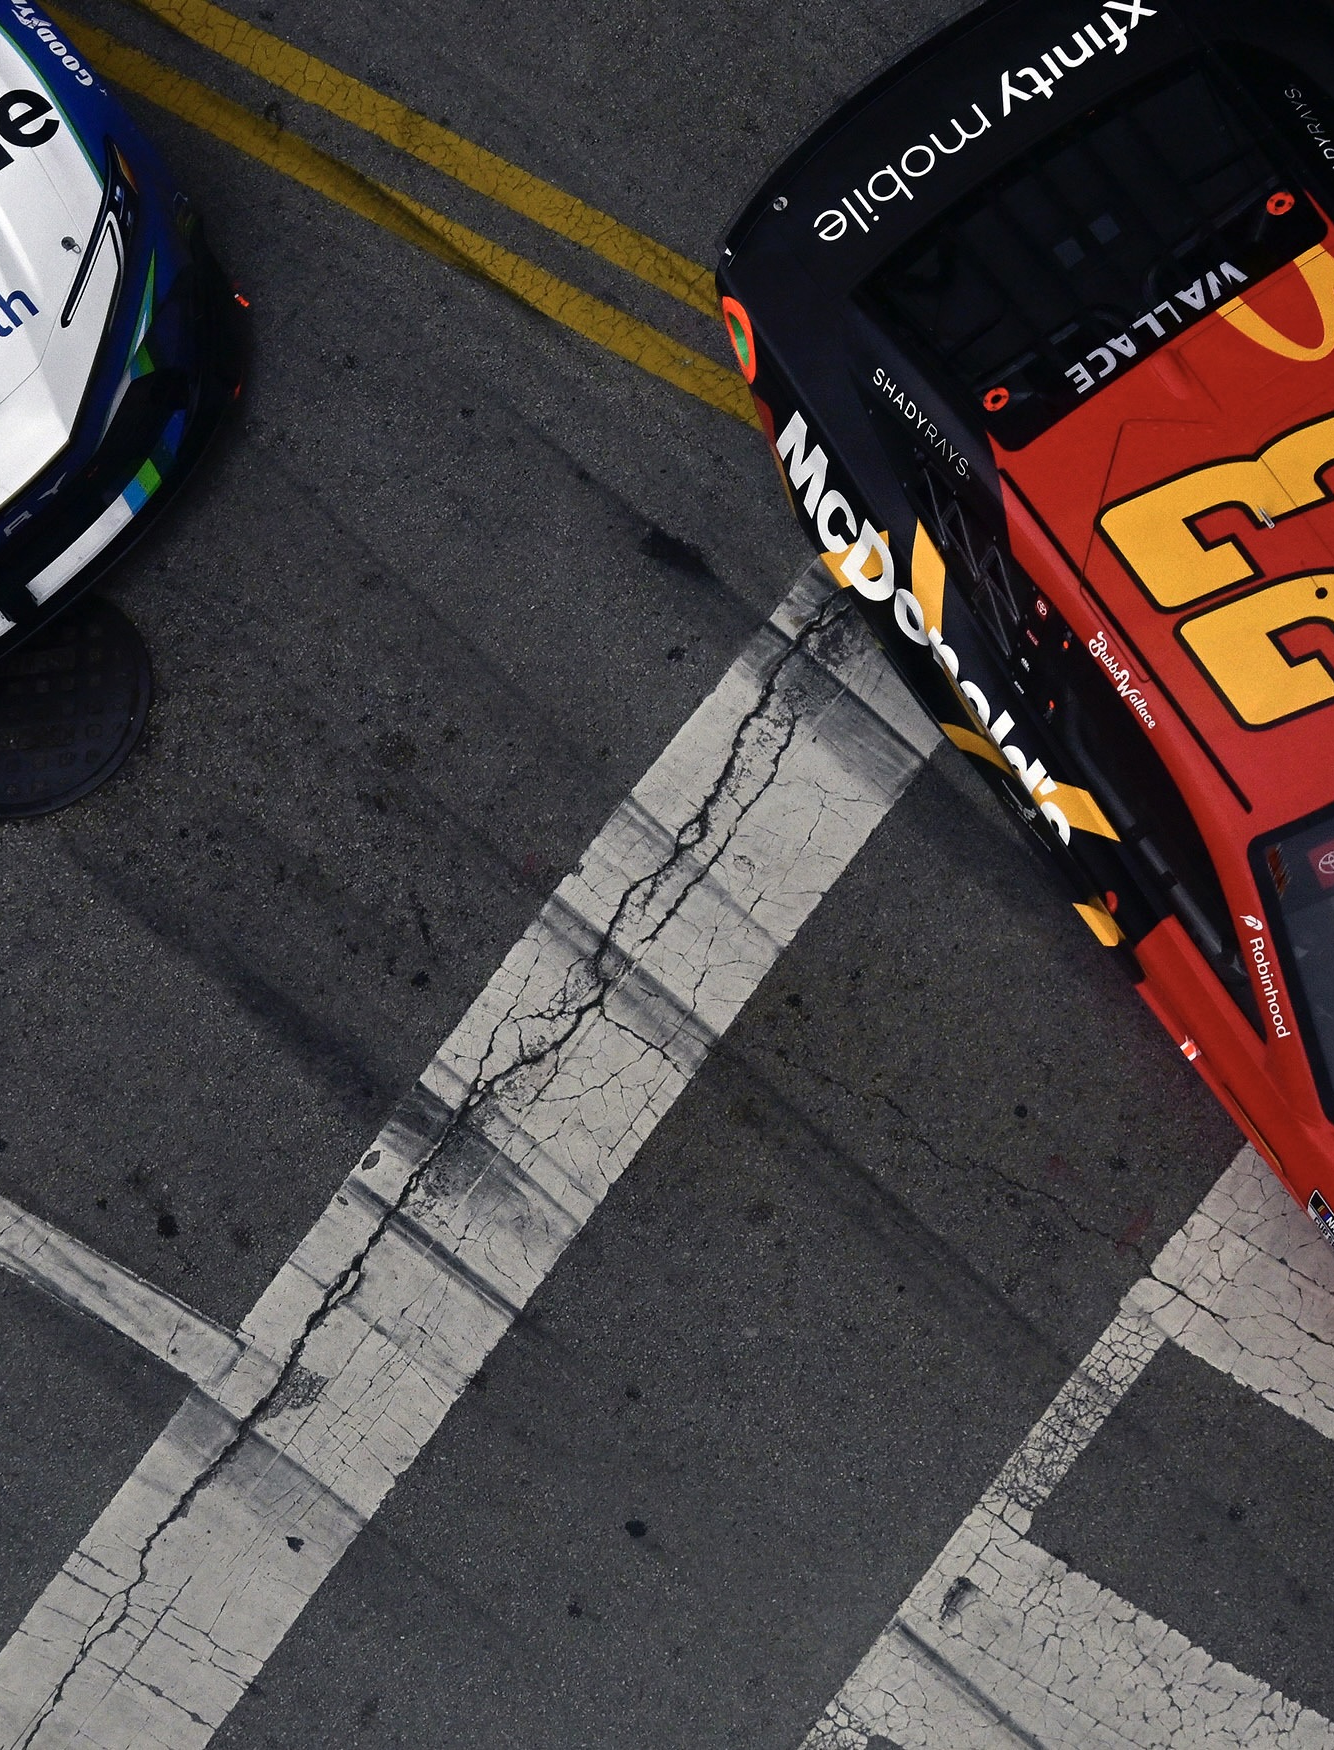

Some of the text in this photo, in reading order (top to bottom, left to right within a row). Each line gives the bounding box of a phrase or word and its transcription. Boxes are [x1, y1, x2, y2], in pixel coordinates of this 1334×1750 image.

[813, 0, 1157, 243] xfinity mobile
[1064, 261, 1248, 395] WALLACE
[1088, 631, 1156, 729] Bubba Wallace
[1250, 936, 1291, 1039] Robinhood
